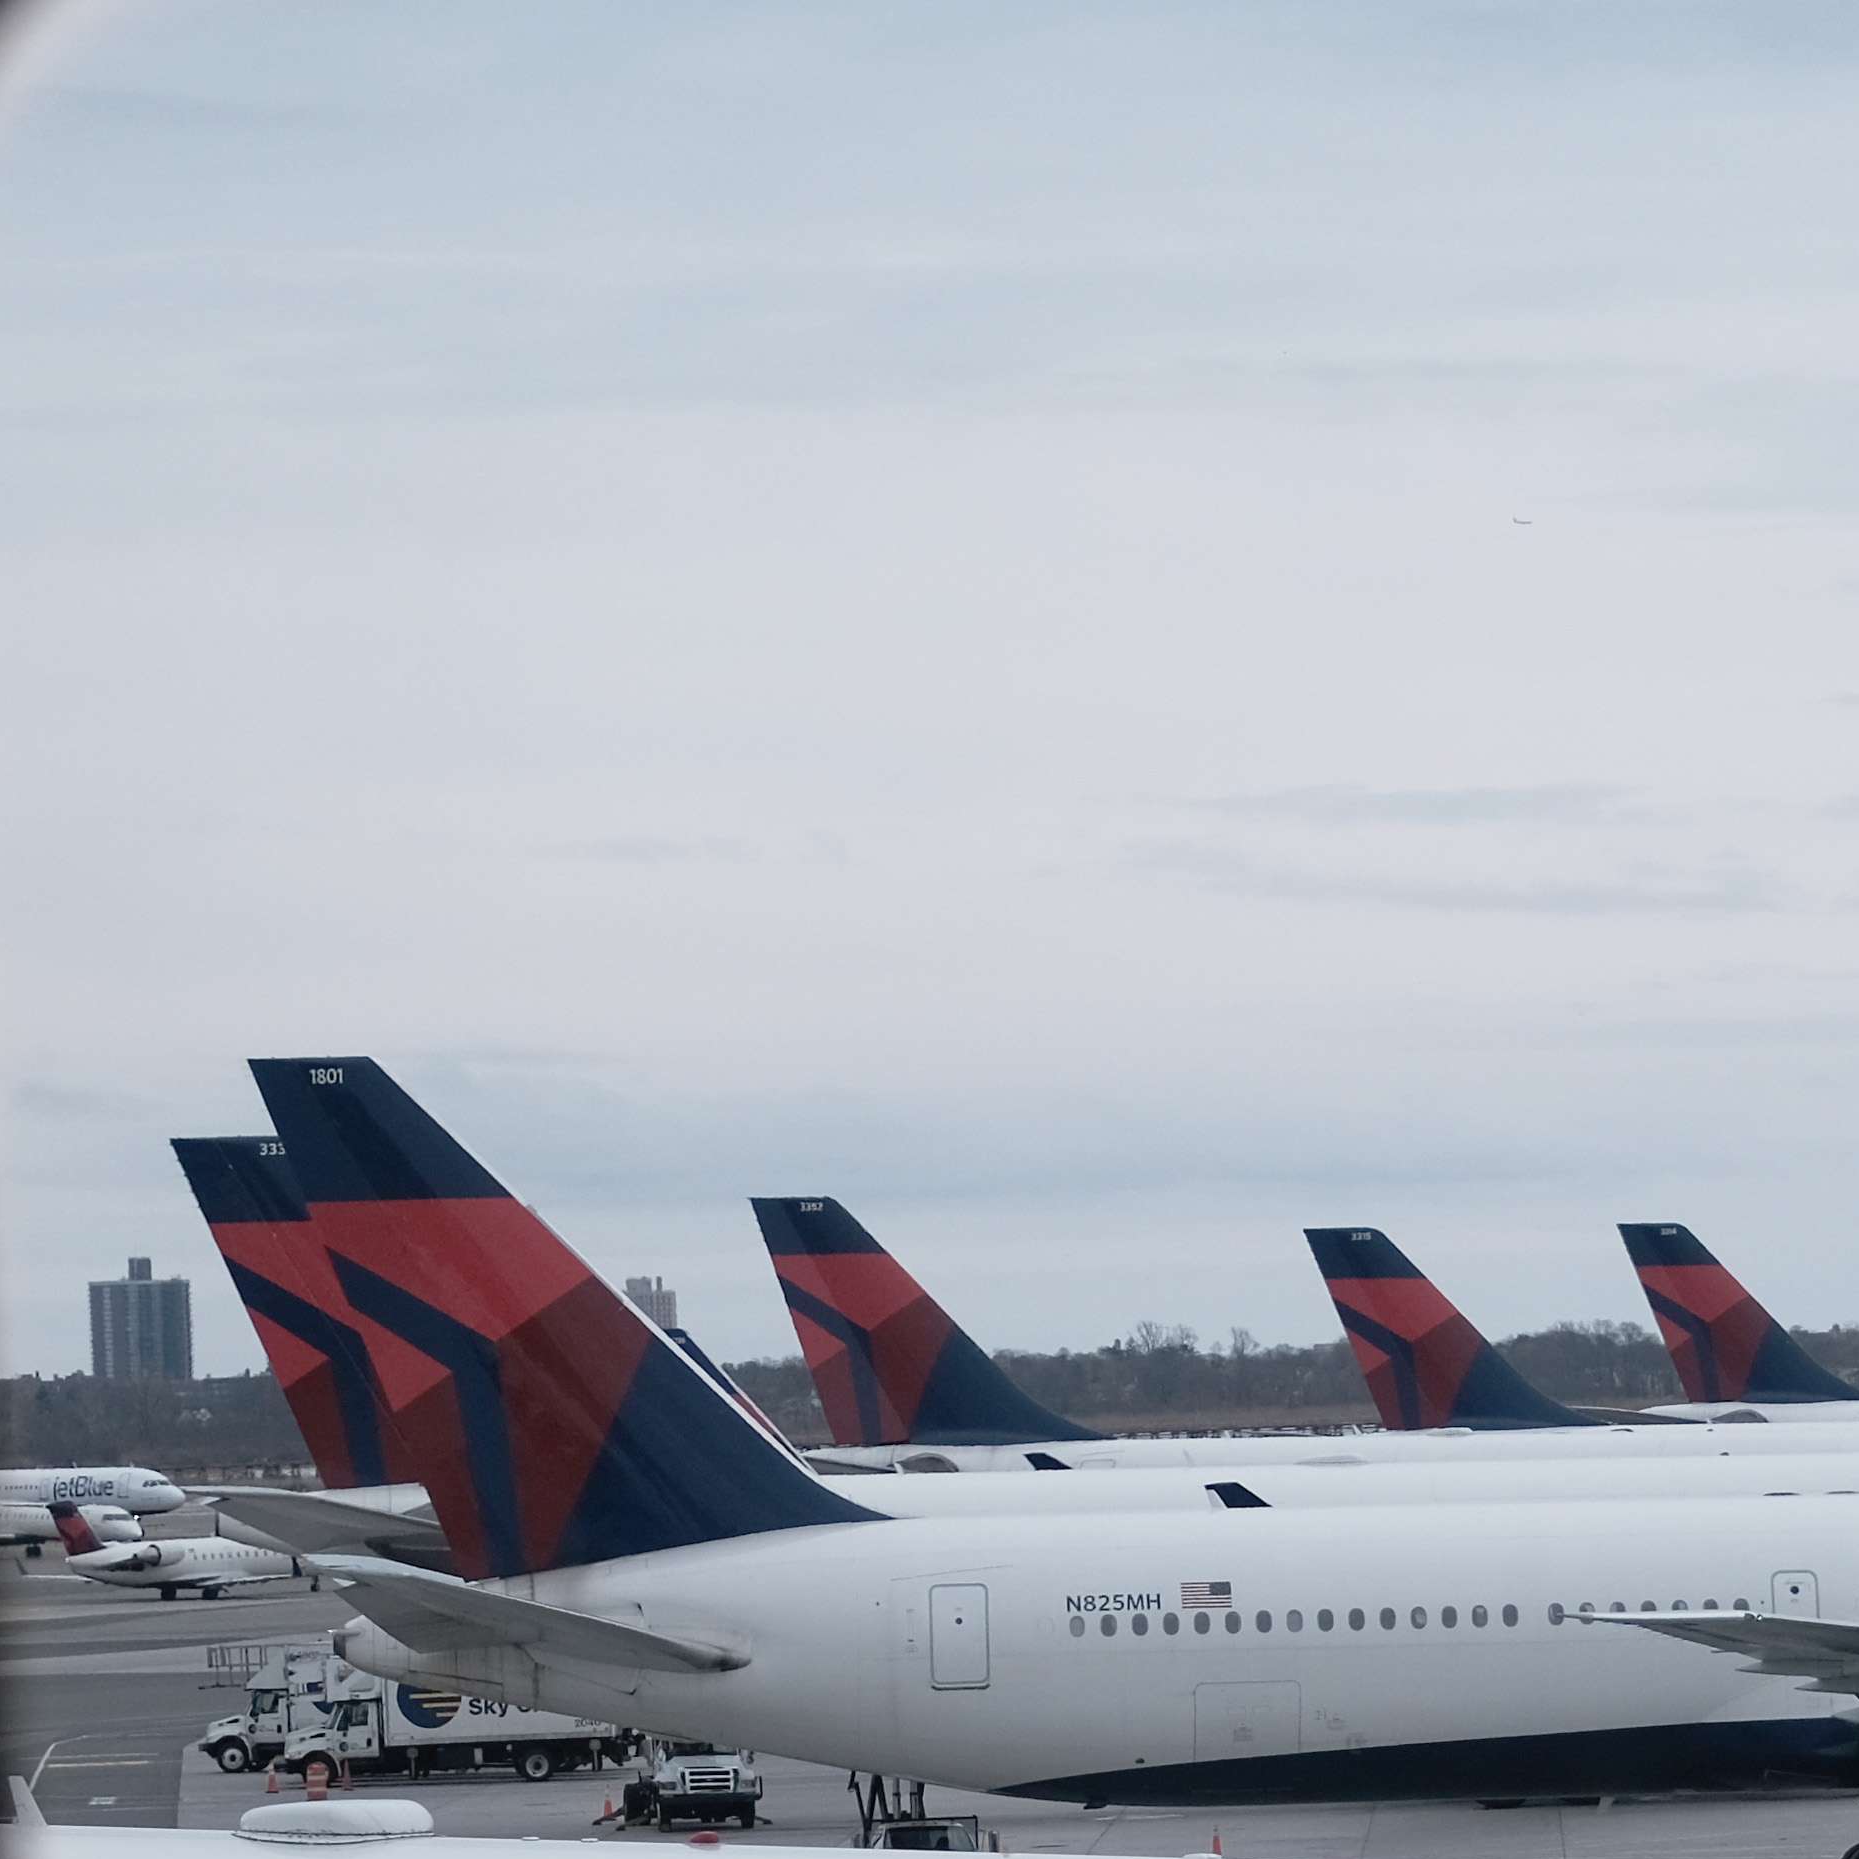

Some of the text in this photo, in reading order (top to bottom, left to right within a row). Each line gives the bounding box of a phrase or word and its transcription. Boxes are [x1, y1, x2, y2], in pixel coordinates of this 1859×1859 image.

[309, 1068, 344, 1085] 1801
[53, 1476, 114, 1499] jetBlue
[1066, 1593, 1162, 1613] N825MH
[468, 1698, 508, 1718] Sky
